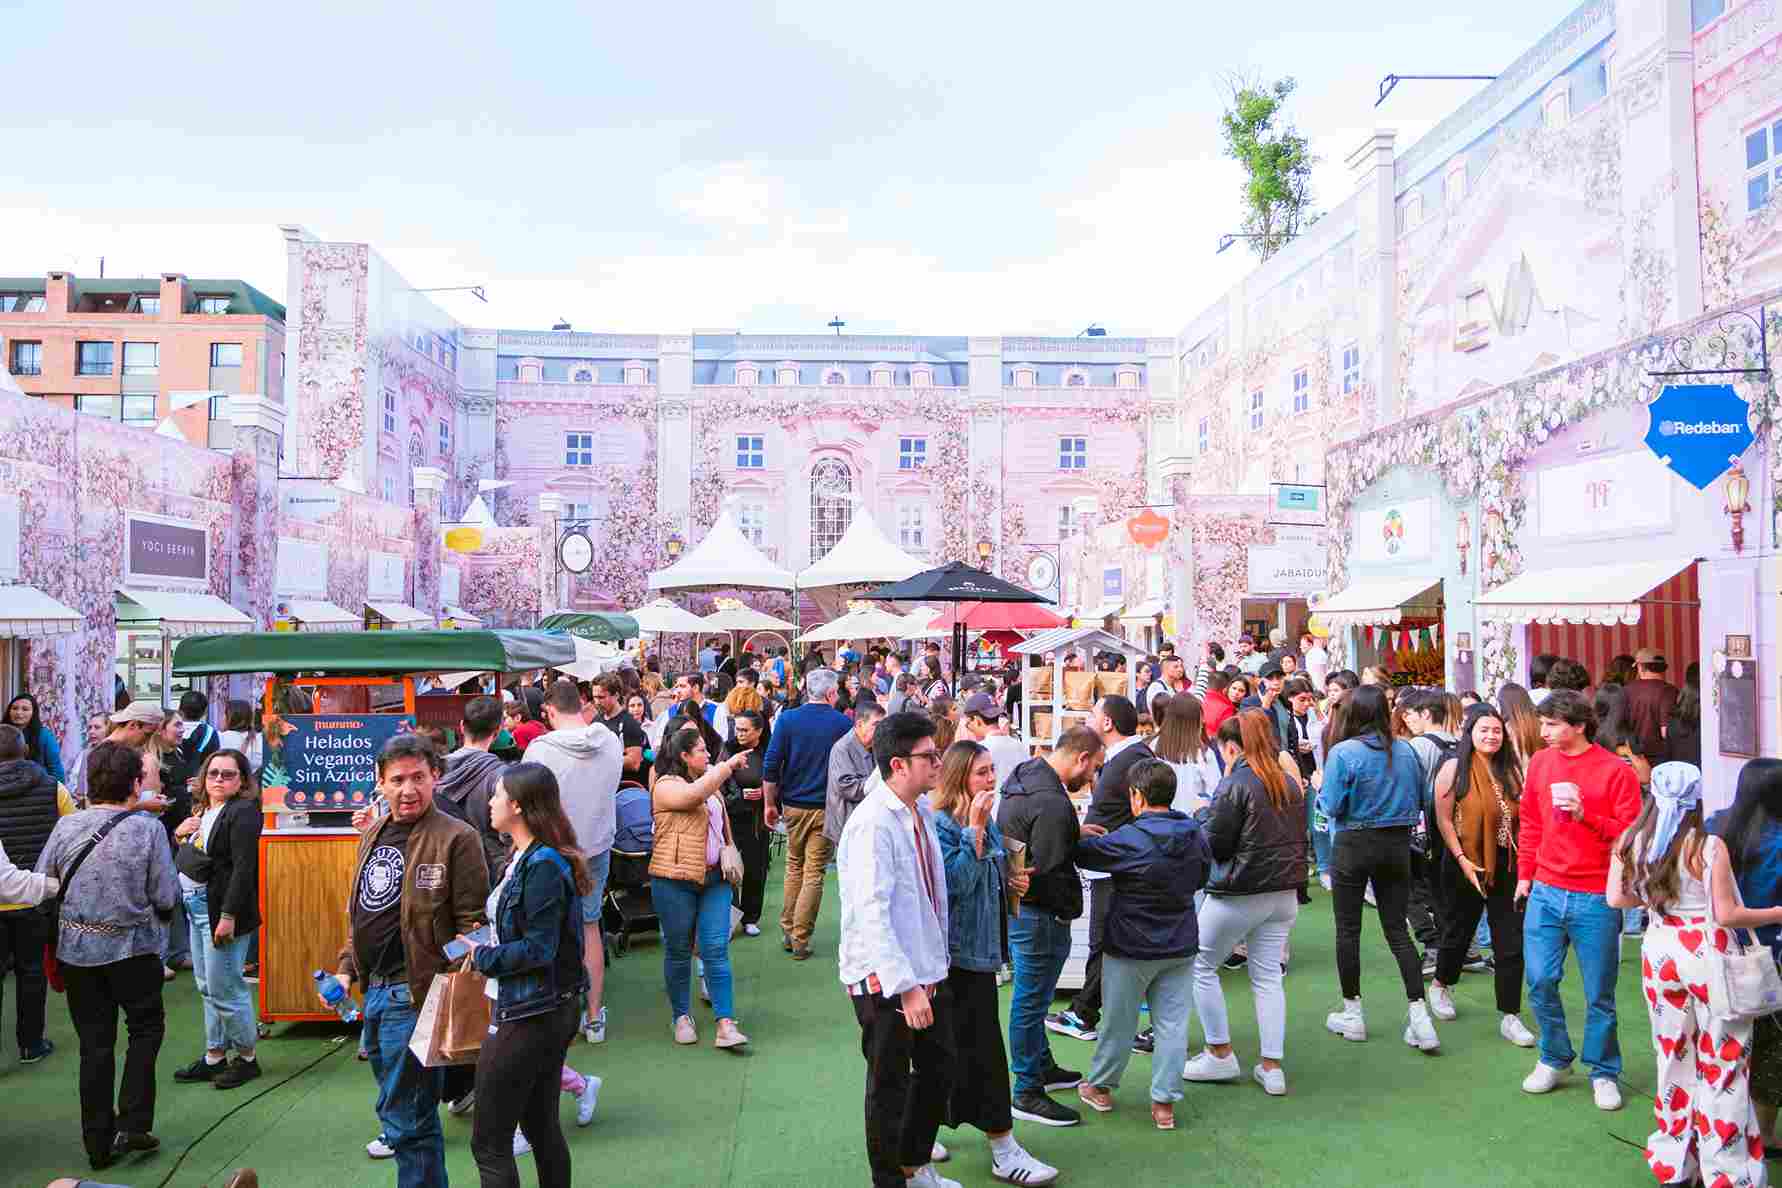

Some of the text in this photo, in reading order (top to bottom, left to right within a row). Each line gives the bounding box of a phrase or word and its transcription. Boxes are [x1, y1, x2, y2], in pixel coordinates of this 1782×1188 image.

[1673, 420, 1740, 434] Redeban
[305, 734, 372, 749] Helados
[303, 752, 374, 769] Veganos
[295, 766, 375, 783] Sin Azúca
